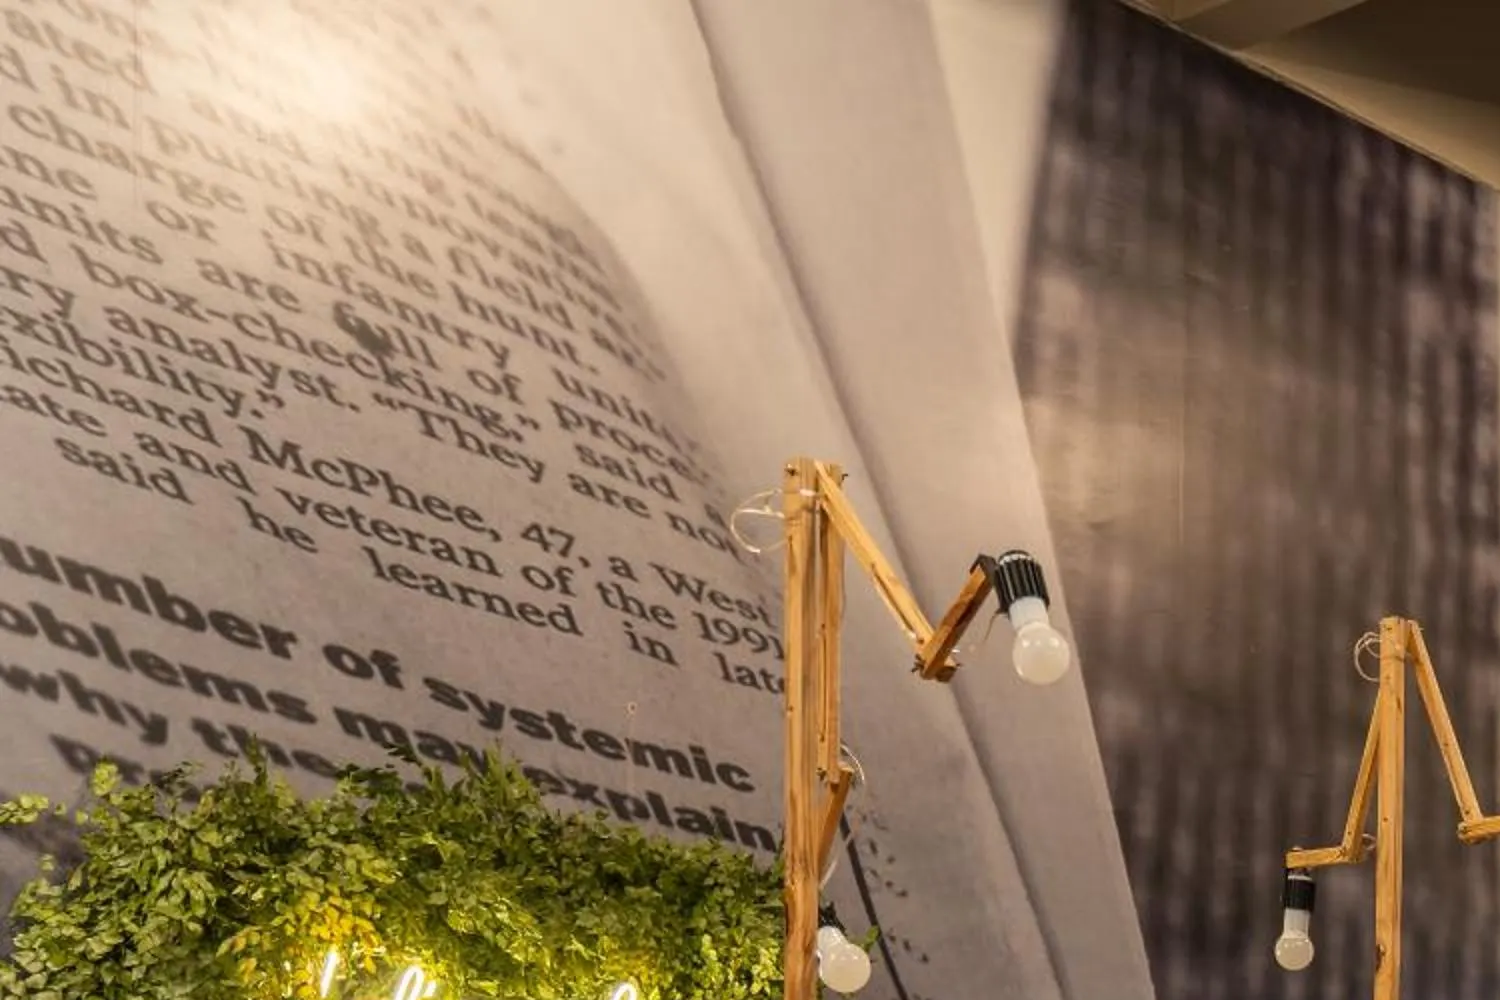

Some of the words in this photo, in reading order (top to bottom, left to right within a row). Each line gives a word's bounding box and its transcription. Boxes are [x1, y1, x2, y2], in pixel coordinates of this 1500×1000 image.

[0, 144, 98, 200] ne
[146, 201, 217, 245] or
[260, 228, 512, 370] infantry
[7, 104, 247, 214] charge
[264, 204, 328, 247] of
[342, 235, 440, 301] the
[447, 280, 601, 375] hunt.
[50, 63, 131, 131] in
[446, 246, 582, 334] field
[0, 265, 76, 320] ry
[102, 305, 361, 414] analyst.
[566, 471, 653, 520] are
[195, 257, 305, 314] are
[331, 299, 444, 372] full
[466, 367, 525, 408] of
[0, 383, 108, 437] ate
[132, 431, 259, 496] and
[272, 485, 502, 578] veteran
[519, 564, 577, 598] of
[595, 581, 678, 631] the
[54, 436, 196, 505] said
[234, 495, 320, 554] he
[360, 544, 585, 637] learned
[622, 619, 681, 669] in
[236, 423, 501, 544] McPhee,
[520, 521, 592, 568] 47,
[607, 555, 640, 583] a
[648, 562, 777, 630] West
[573, 440, 681, 504] said
[321, 643, 405, 690] of
[423, 676, 756, 793] systemic
[521, 764, 779, 854] explain
